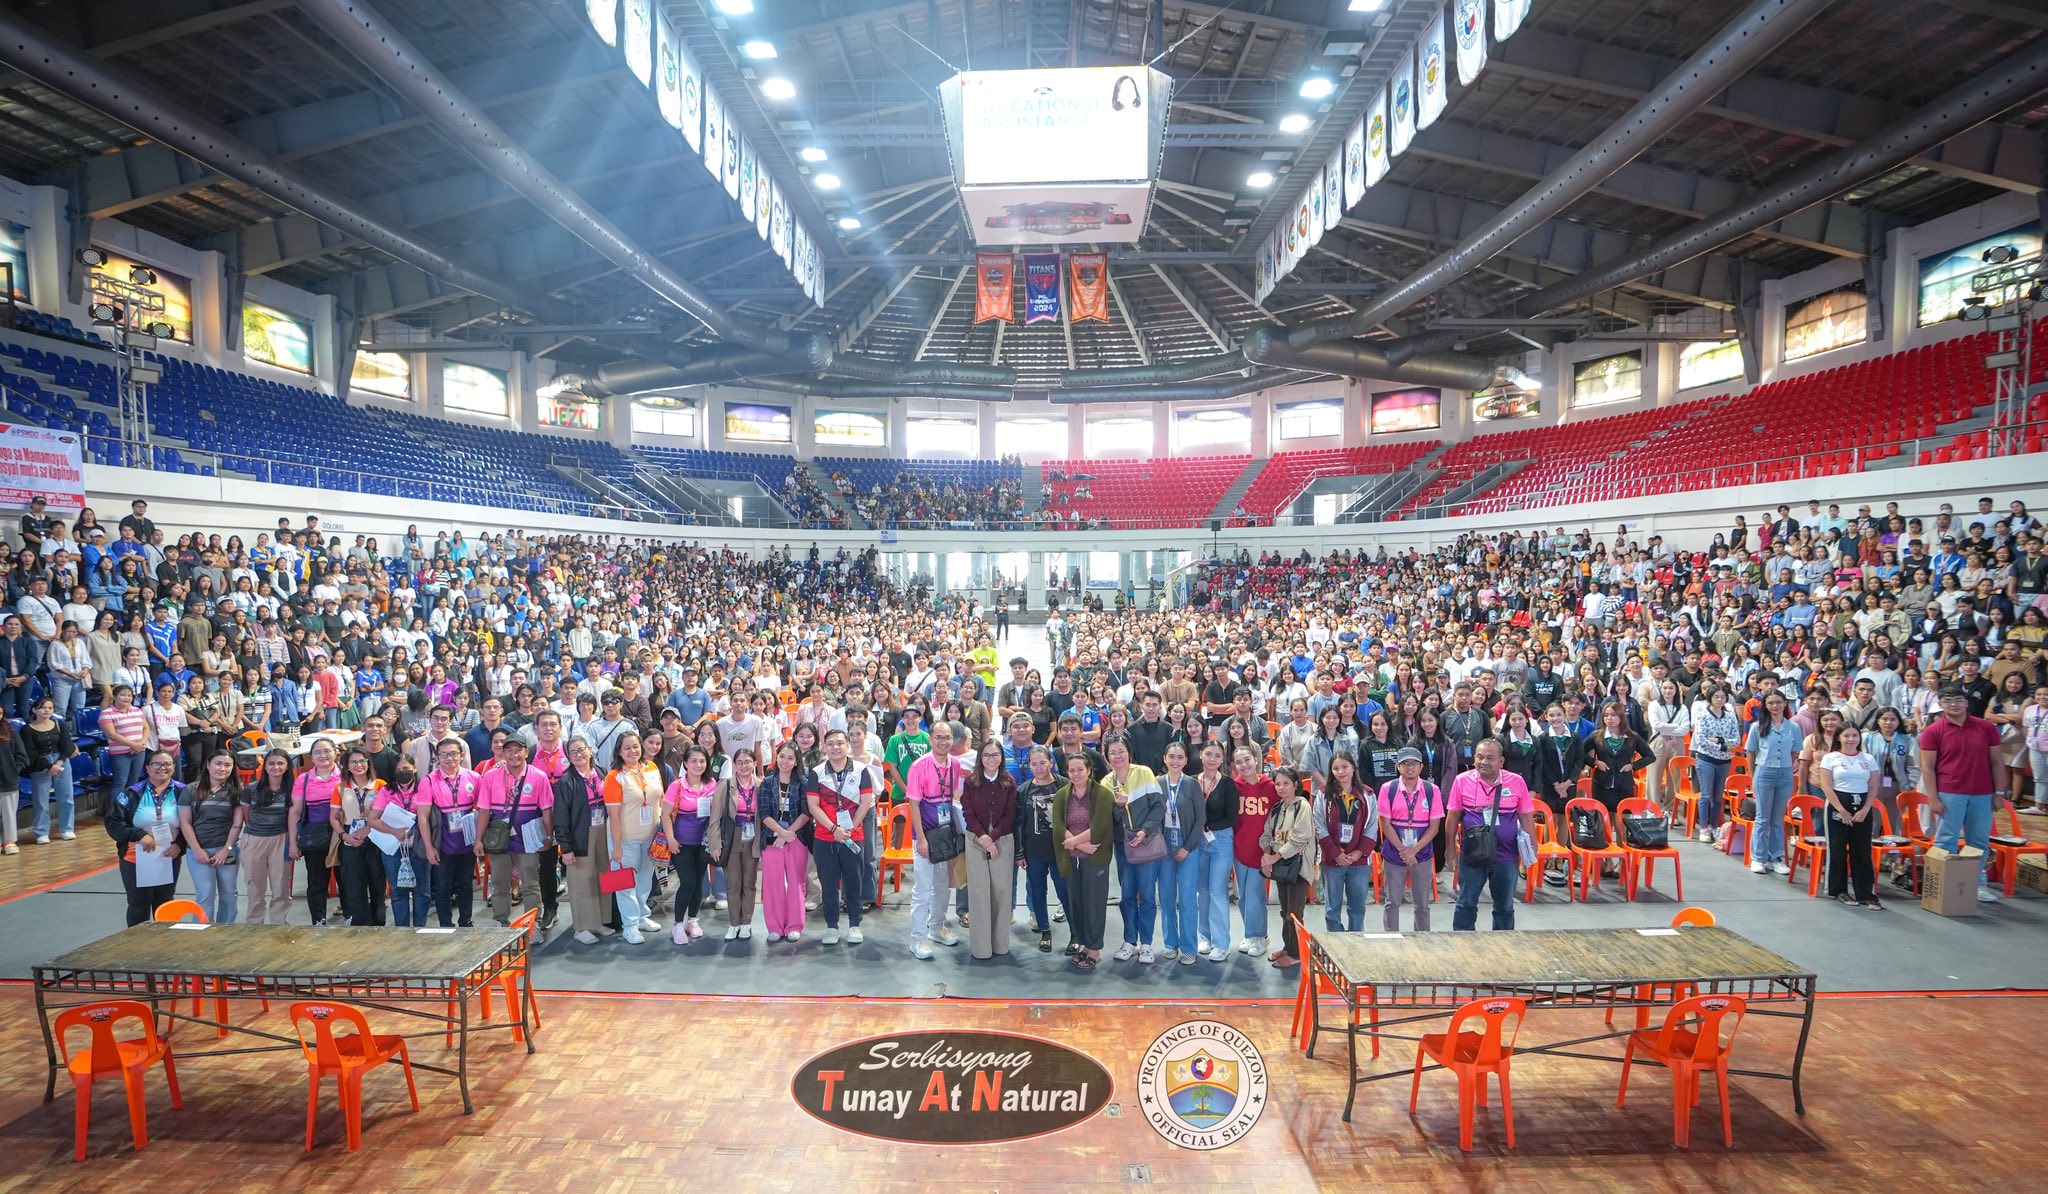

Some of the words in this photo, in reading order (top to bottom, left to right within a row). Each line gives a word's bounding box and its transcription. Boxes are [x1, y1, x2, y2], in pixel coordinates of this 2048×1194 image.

[1029, 264, 1056, 274] TITANS
[322, 522, 345, 530] DOLORES
[859, 1039, 1033, 1078] Serbisyong
[1141, 1025, 1197, 1086] PROVINCE
[1200, 1024, 1221, 1036] OF
[1222, 1030, 1264, 1085] QUEZON
[817, 1070, 912, 1119] Tunay
[919, 1070, 962, 1111] At
[971, 1070, 1088, 1111] Natural
[1151, 1111, 1218, 1147] OFFICIAL
[1222, 1112, 1255, 1142] SEAL
